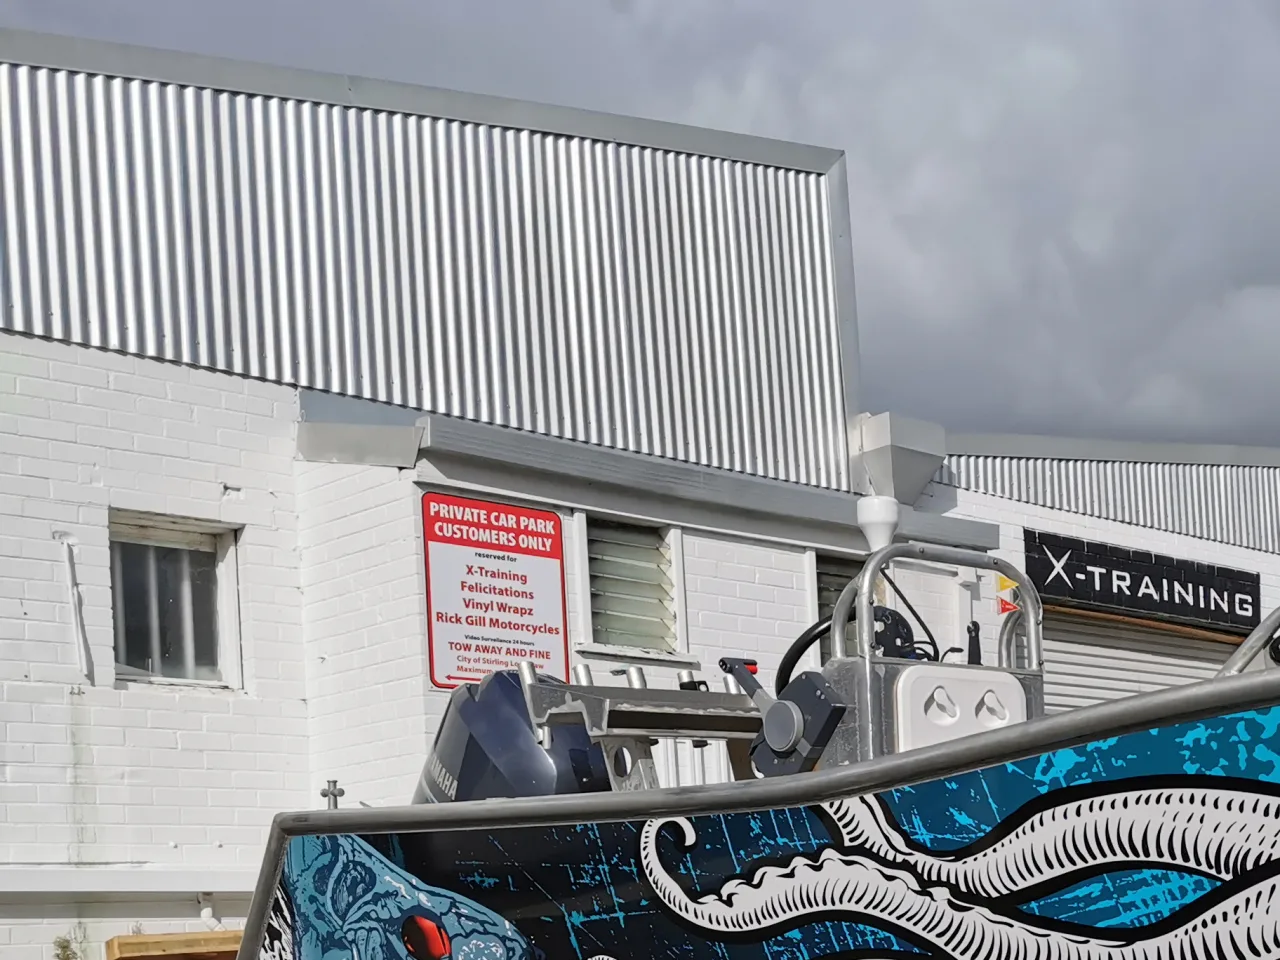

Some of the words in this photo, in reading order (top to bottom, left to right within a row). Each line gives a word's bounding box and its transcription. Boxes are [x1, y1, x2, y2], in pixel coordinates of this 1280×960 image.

[430, 502, 487, 525] PRIVATE
[491, 512, 516, 528] CAR
[520, 516, 555, 534] PARK
[434, 522, 516, 547] CUSTOMERS
[519, 535, 552, 551] ONLY
[475, 552, 505, 561] reserved
[507, 554, 517, 562] for
[466, 565, 527, 584] X-Training
[1042, 544, 1253, 617] X-TRAINING
[460, 581, 534, 600] Felicitations
[463, 598, 494, 612] Vinyl
[496, 602, 534, 617] Wrapz
[436, 612, 462, 625] Rick
[465, 615, 486, 628] Gill
[489, 618, 560, 635] Motorcycles
[448, 641, 472, 652] TOW
[474, 644, 503, 655] AWAY
[505, 647, 527, 658] AND
[530, 650, 551, 660] FINE
[457, 655, 472, 664] City
[482, 657, 509, 667] Stirling
